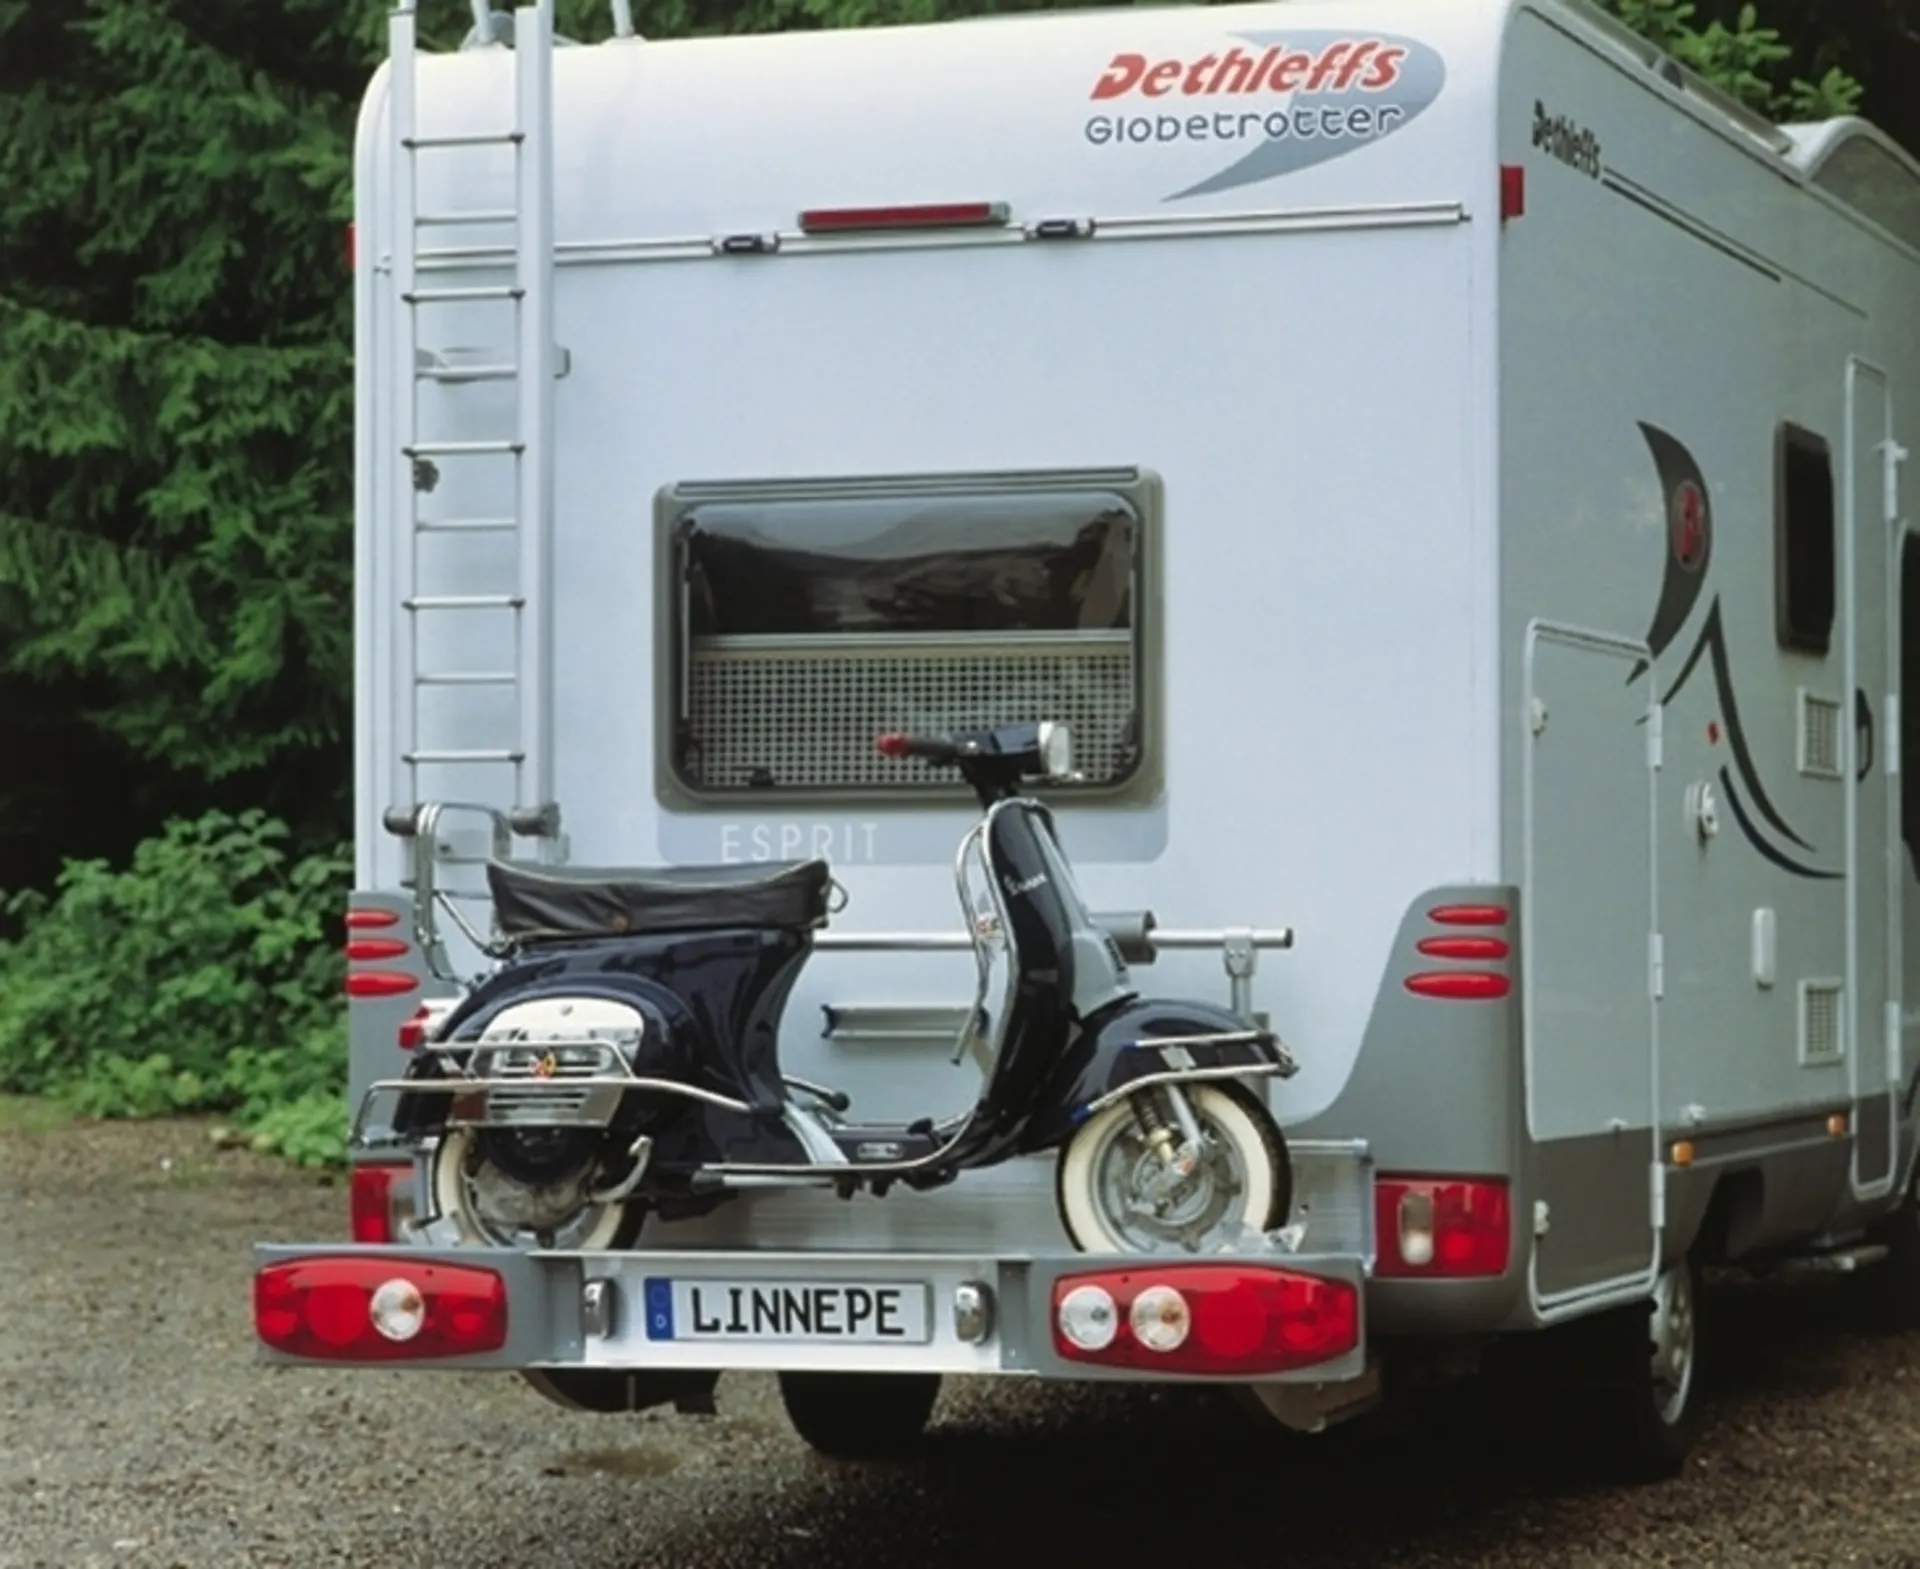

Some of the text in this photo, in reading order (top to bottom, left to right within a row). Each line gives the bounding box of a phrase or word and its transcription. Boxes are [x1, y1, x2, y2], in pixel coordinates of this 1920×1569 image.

[1090, 40, 1405, 101] Dethleffs
[1084, 103, 1402, 145] Globetrotter
[1532, 99, 1601, 180] Dethleffs
[720, 822, 880, 864] ESPRIT
[690, 1286, 906, 1336] LINNEPE
